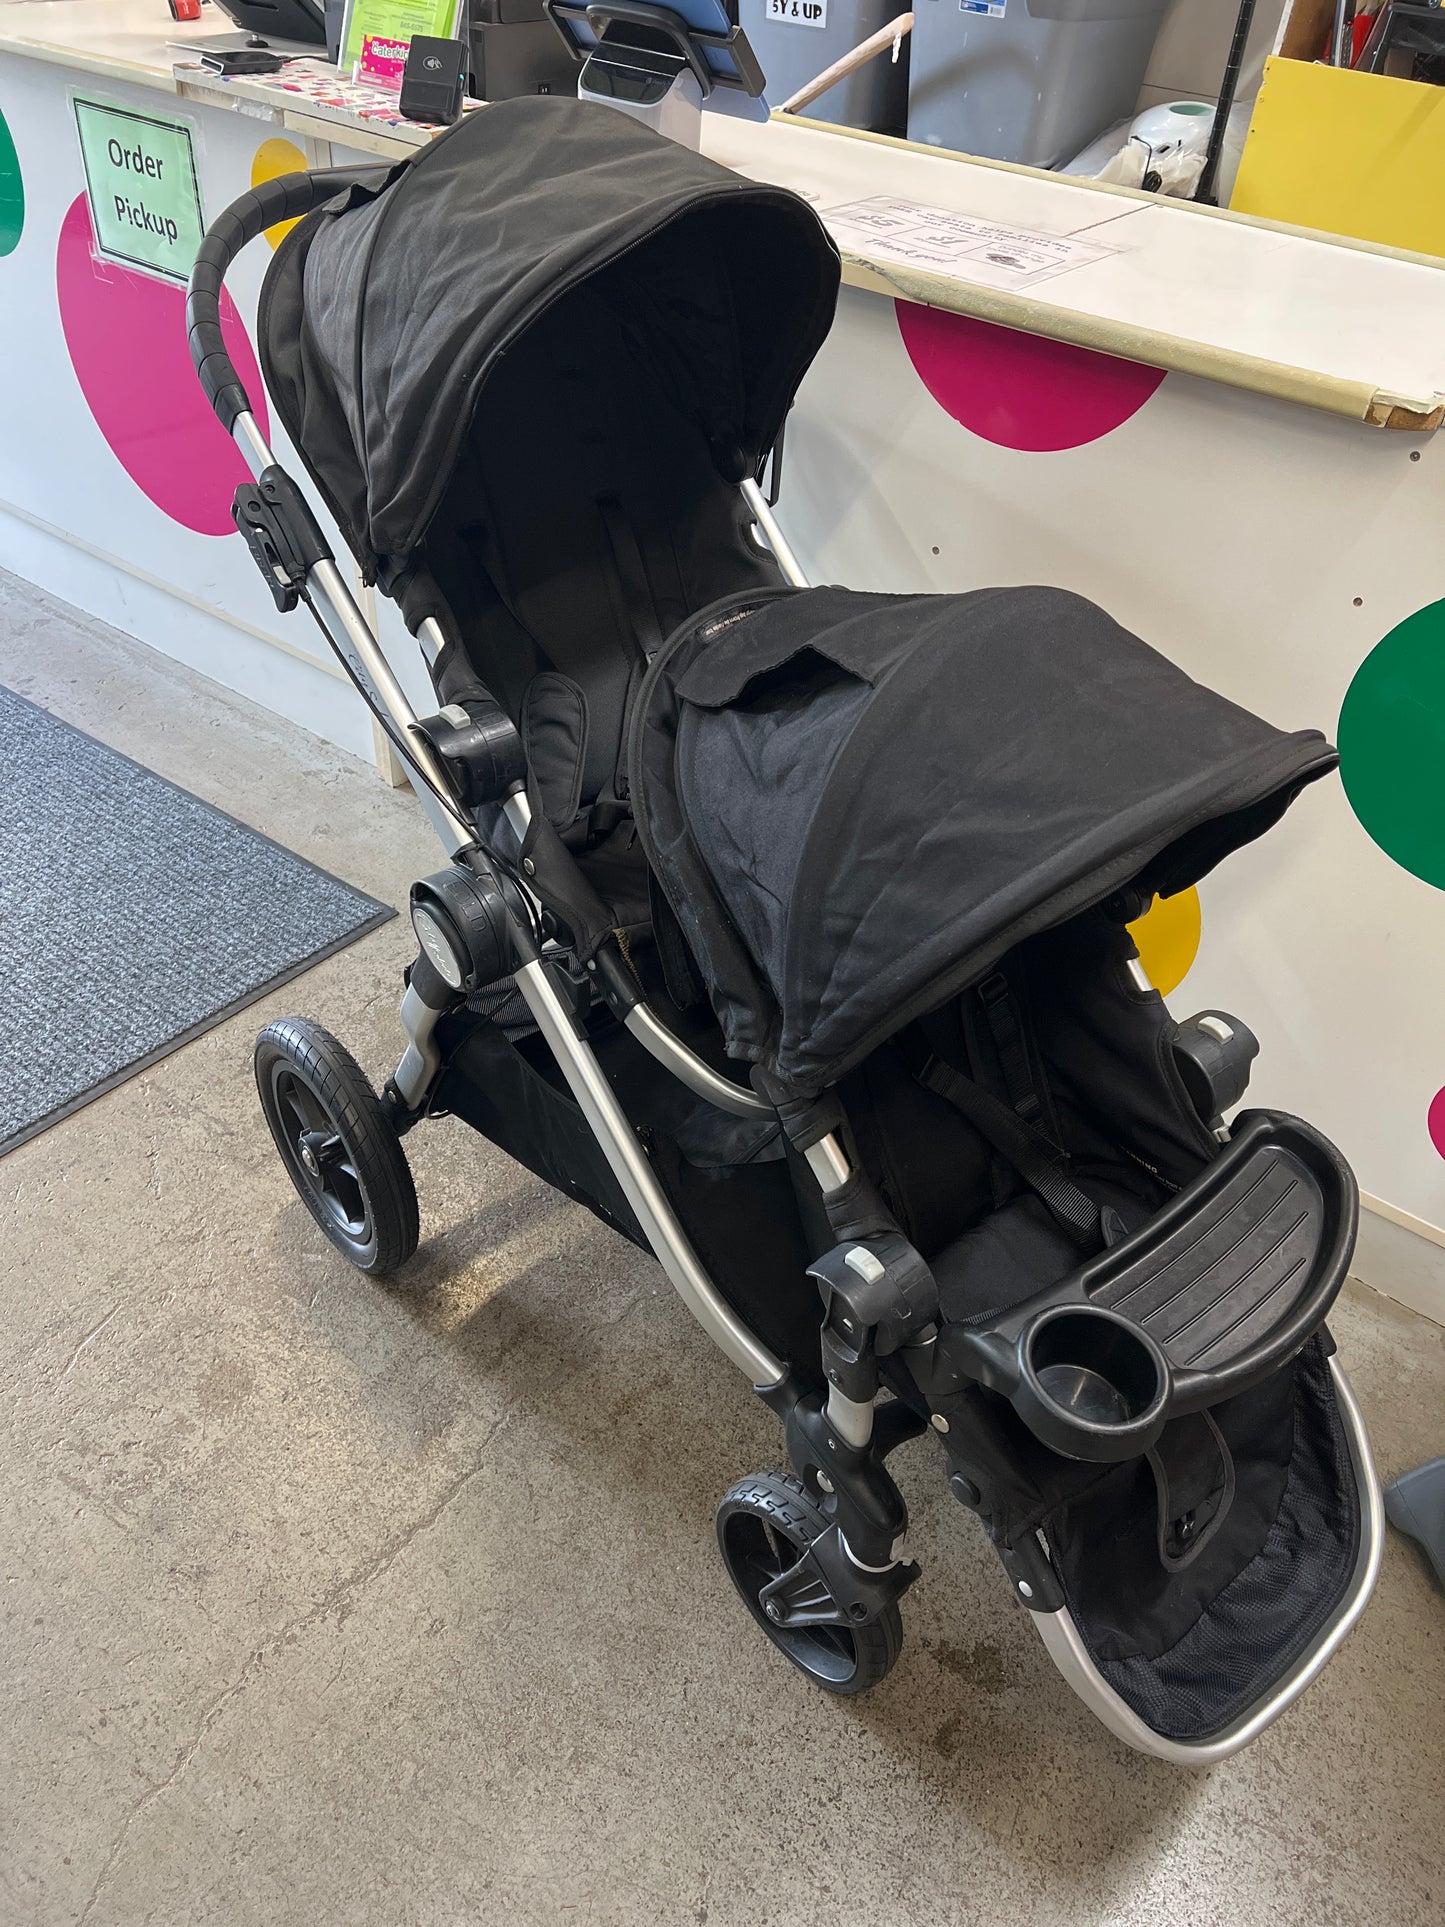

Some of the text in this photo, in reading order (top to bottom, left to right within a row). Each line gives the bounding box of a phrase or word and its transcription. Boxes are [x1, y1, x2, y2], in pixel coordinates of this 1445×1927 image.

[772, 0, 823, 19] 5Y & UP
[107, 138, 163, 180] Order
[113, 194, 178, 245] Pickup
[855, 214, 906, 227] $5
[865, 238, 918, 255] Thank
[925, 236, 969, 245] $1
[443, 880, 487, 933] FOLD
